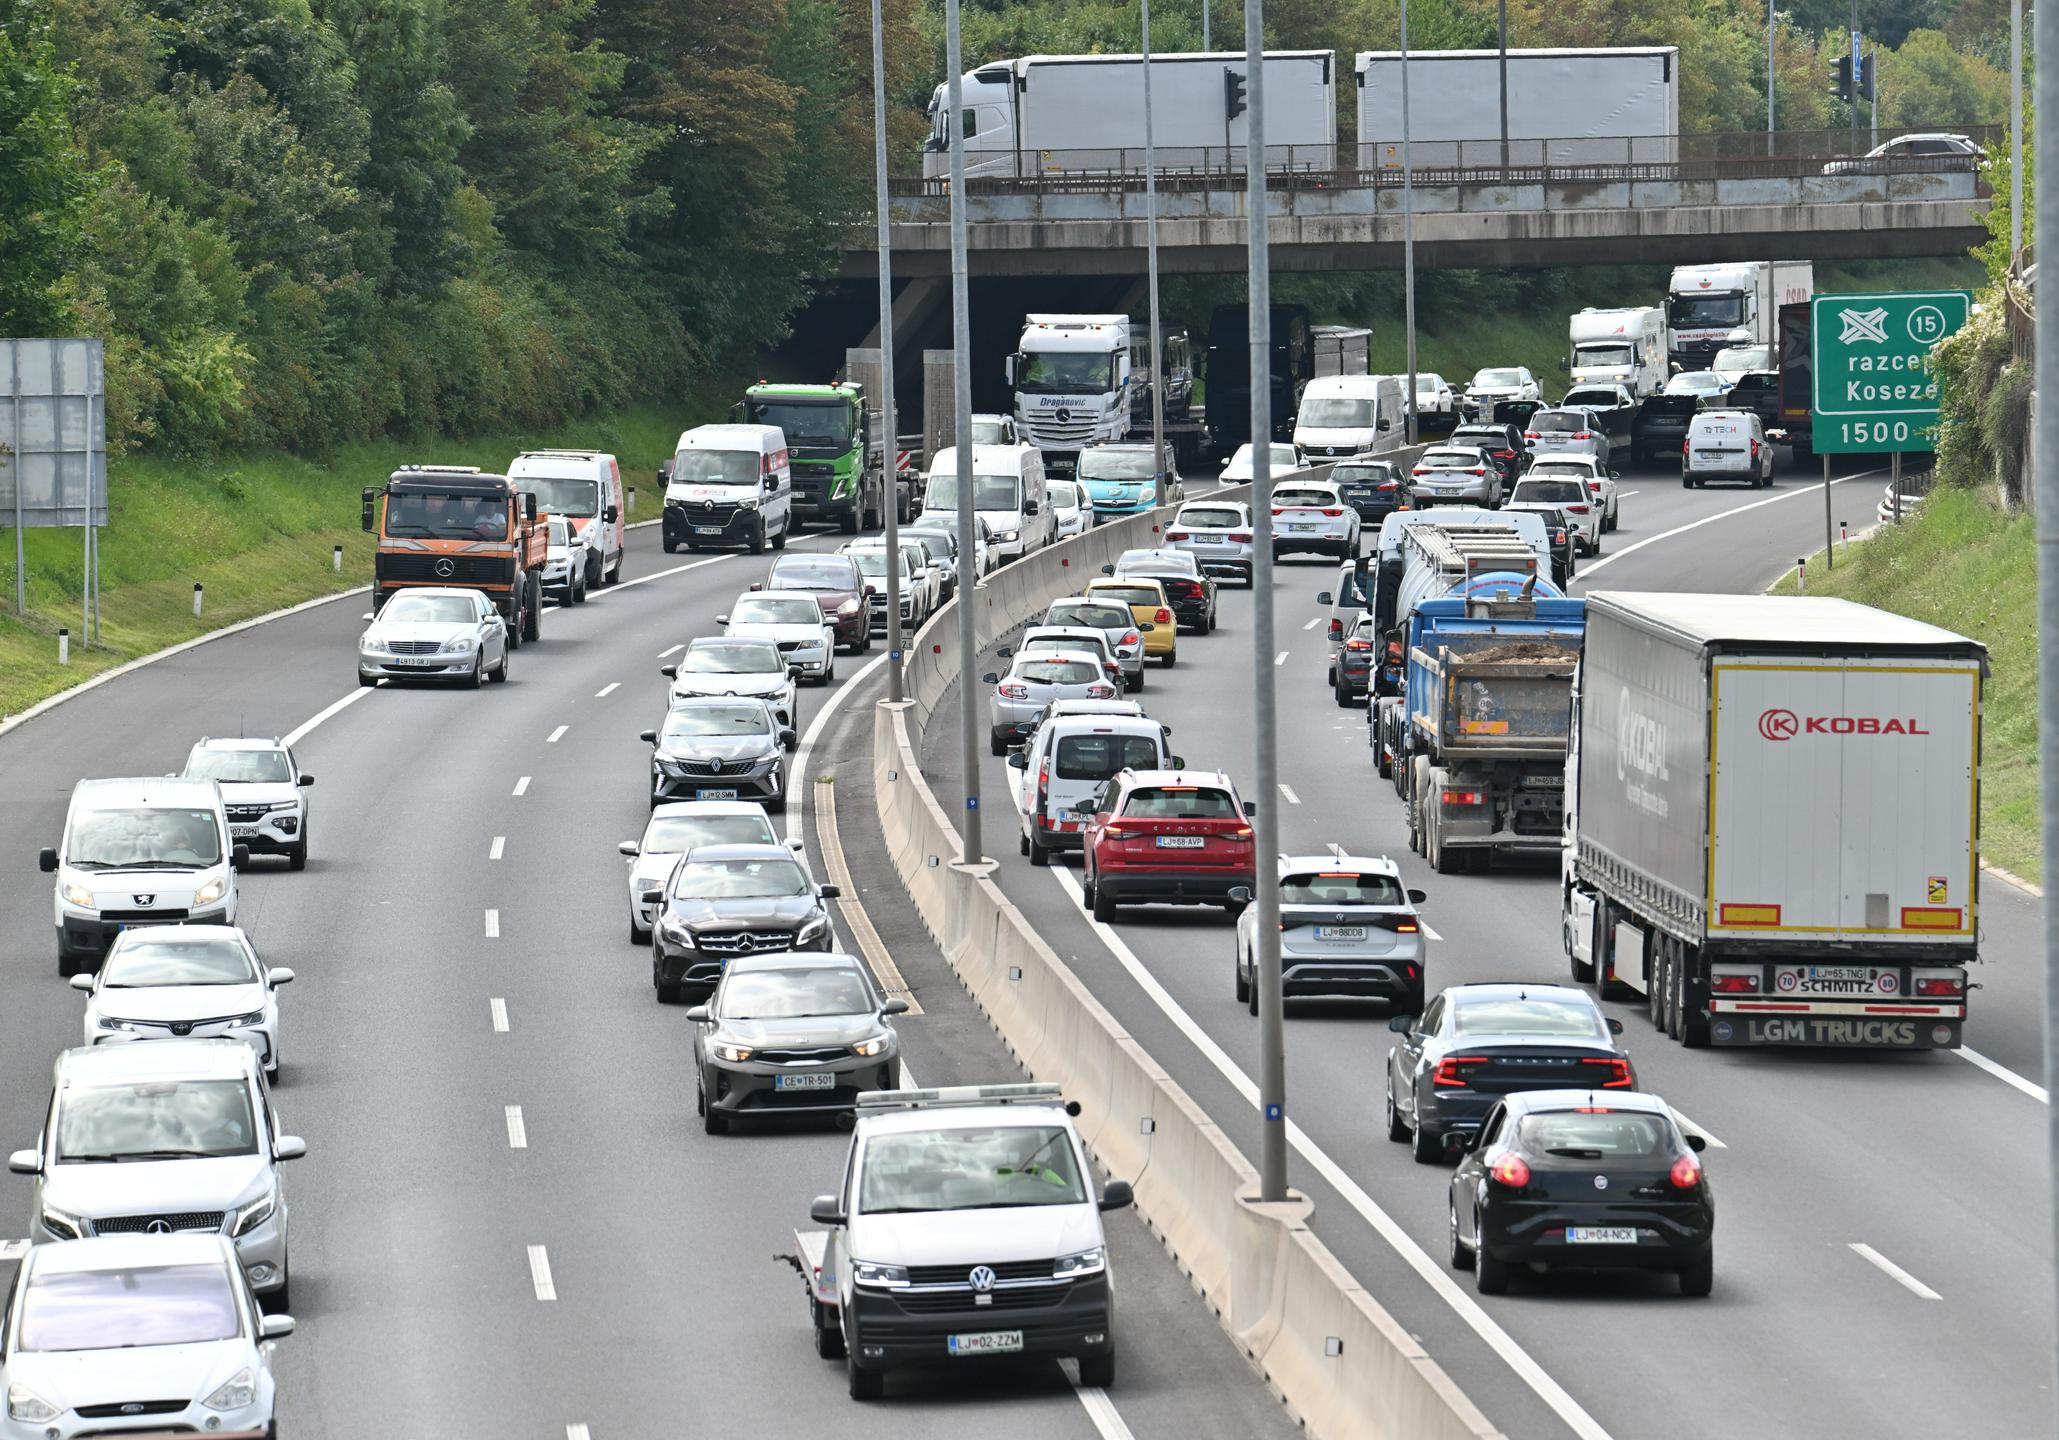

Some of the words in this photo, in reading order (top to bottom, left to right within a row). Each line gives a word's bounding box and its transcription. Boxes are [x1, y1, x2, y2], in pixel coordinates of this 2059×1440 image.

[1916, 316, 1937, 333] 15
[1846, 380, 1938, 402] Koseze
[1713, 426, 1737, 434] TECH
[1841, 421, 1909, 444] 1500
[1805, 717, 1931, 736] KOBAL
[1800, 980, 1874, 994] SCHMITZ
[1749, 1020, 1805, 1042] LGM
[1811, 1020, 1916, 1045] TRUCKS
[803, 1075, 833, 1087] TR-501
[1596, 1229, 1634, 1241] 04-NCK
[979, 1333, 1021, 1349] 02-ZZM
